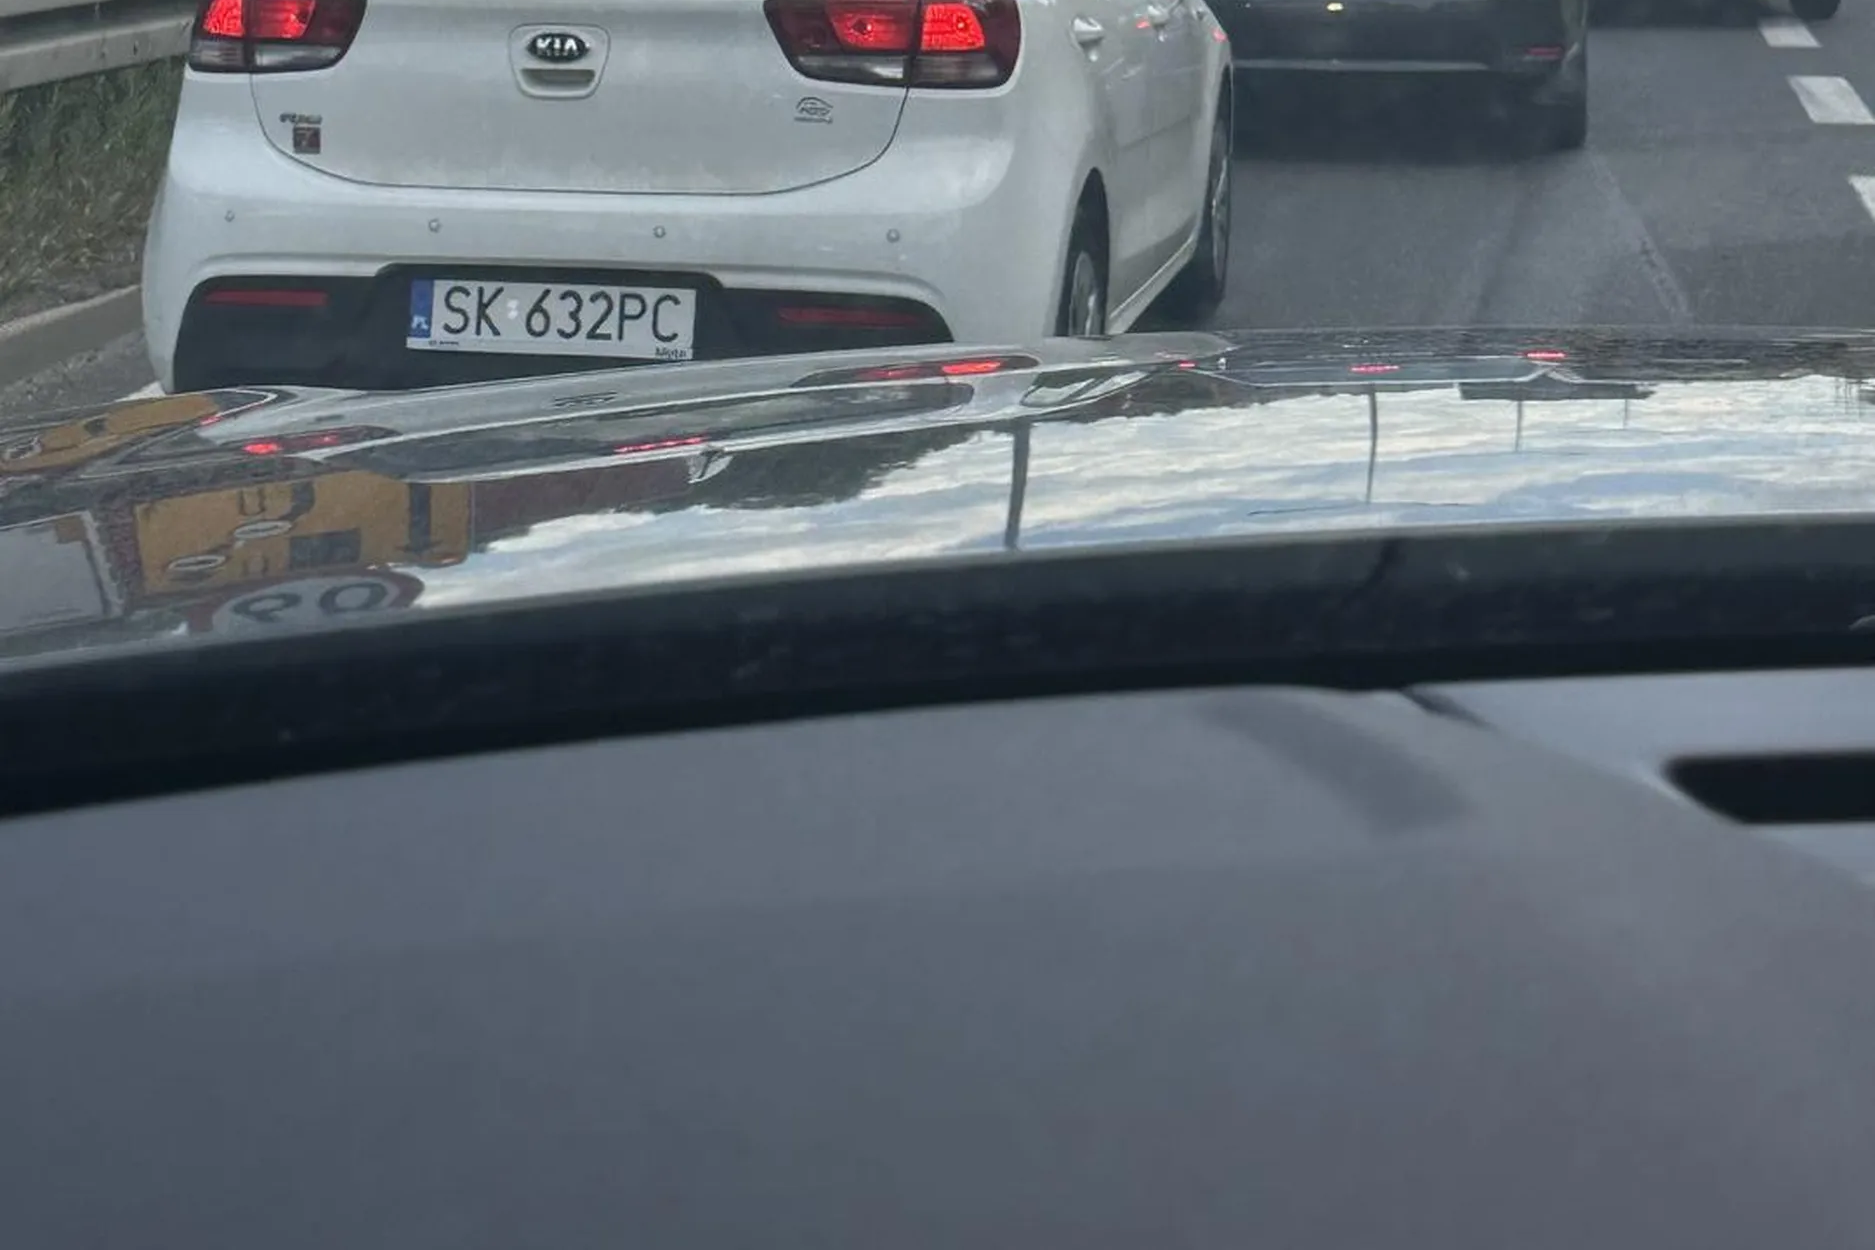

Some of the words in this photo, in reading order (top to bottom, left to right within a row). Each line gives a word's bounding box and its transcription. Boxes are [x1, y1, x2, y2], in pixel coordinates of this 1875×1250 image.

[536, 37, 579, 57] KIA
[442, 285, 504, 337] SK
[525, 288, 681, 343] 632PC
